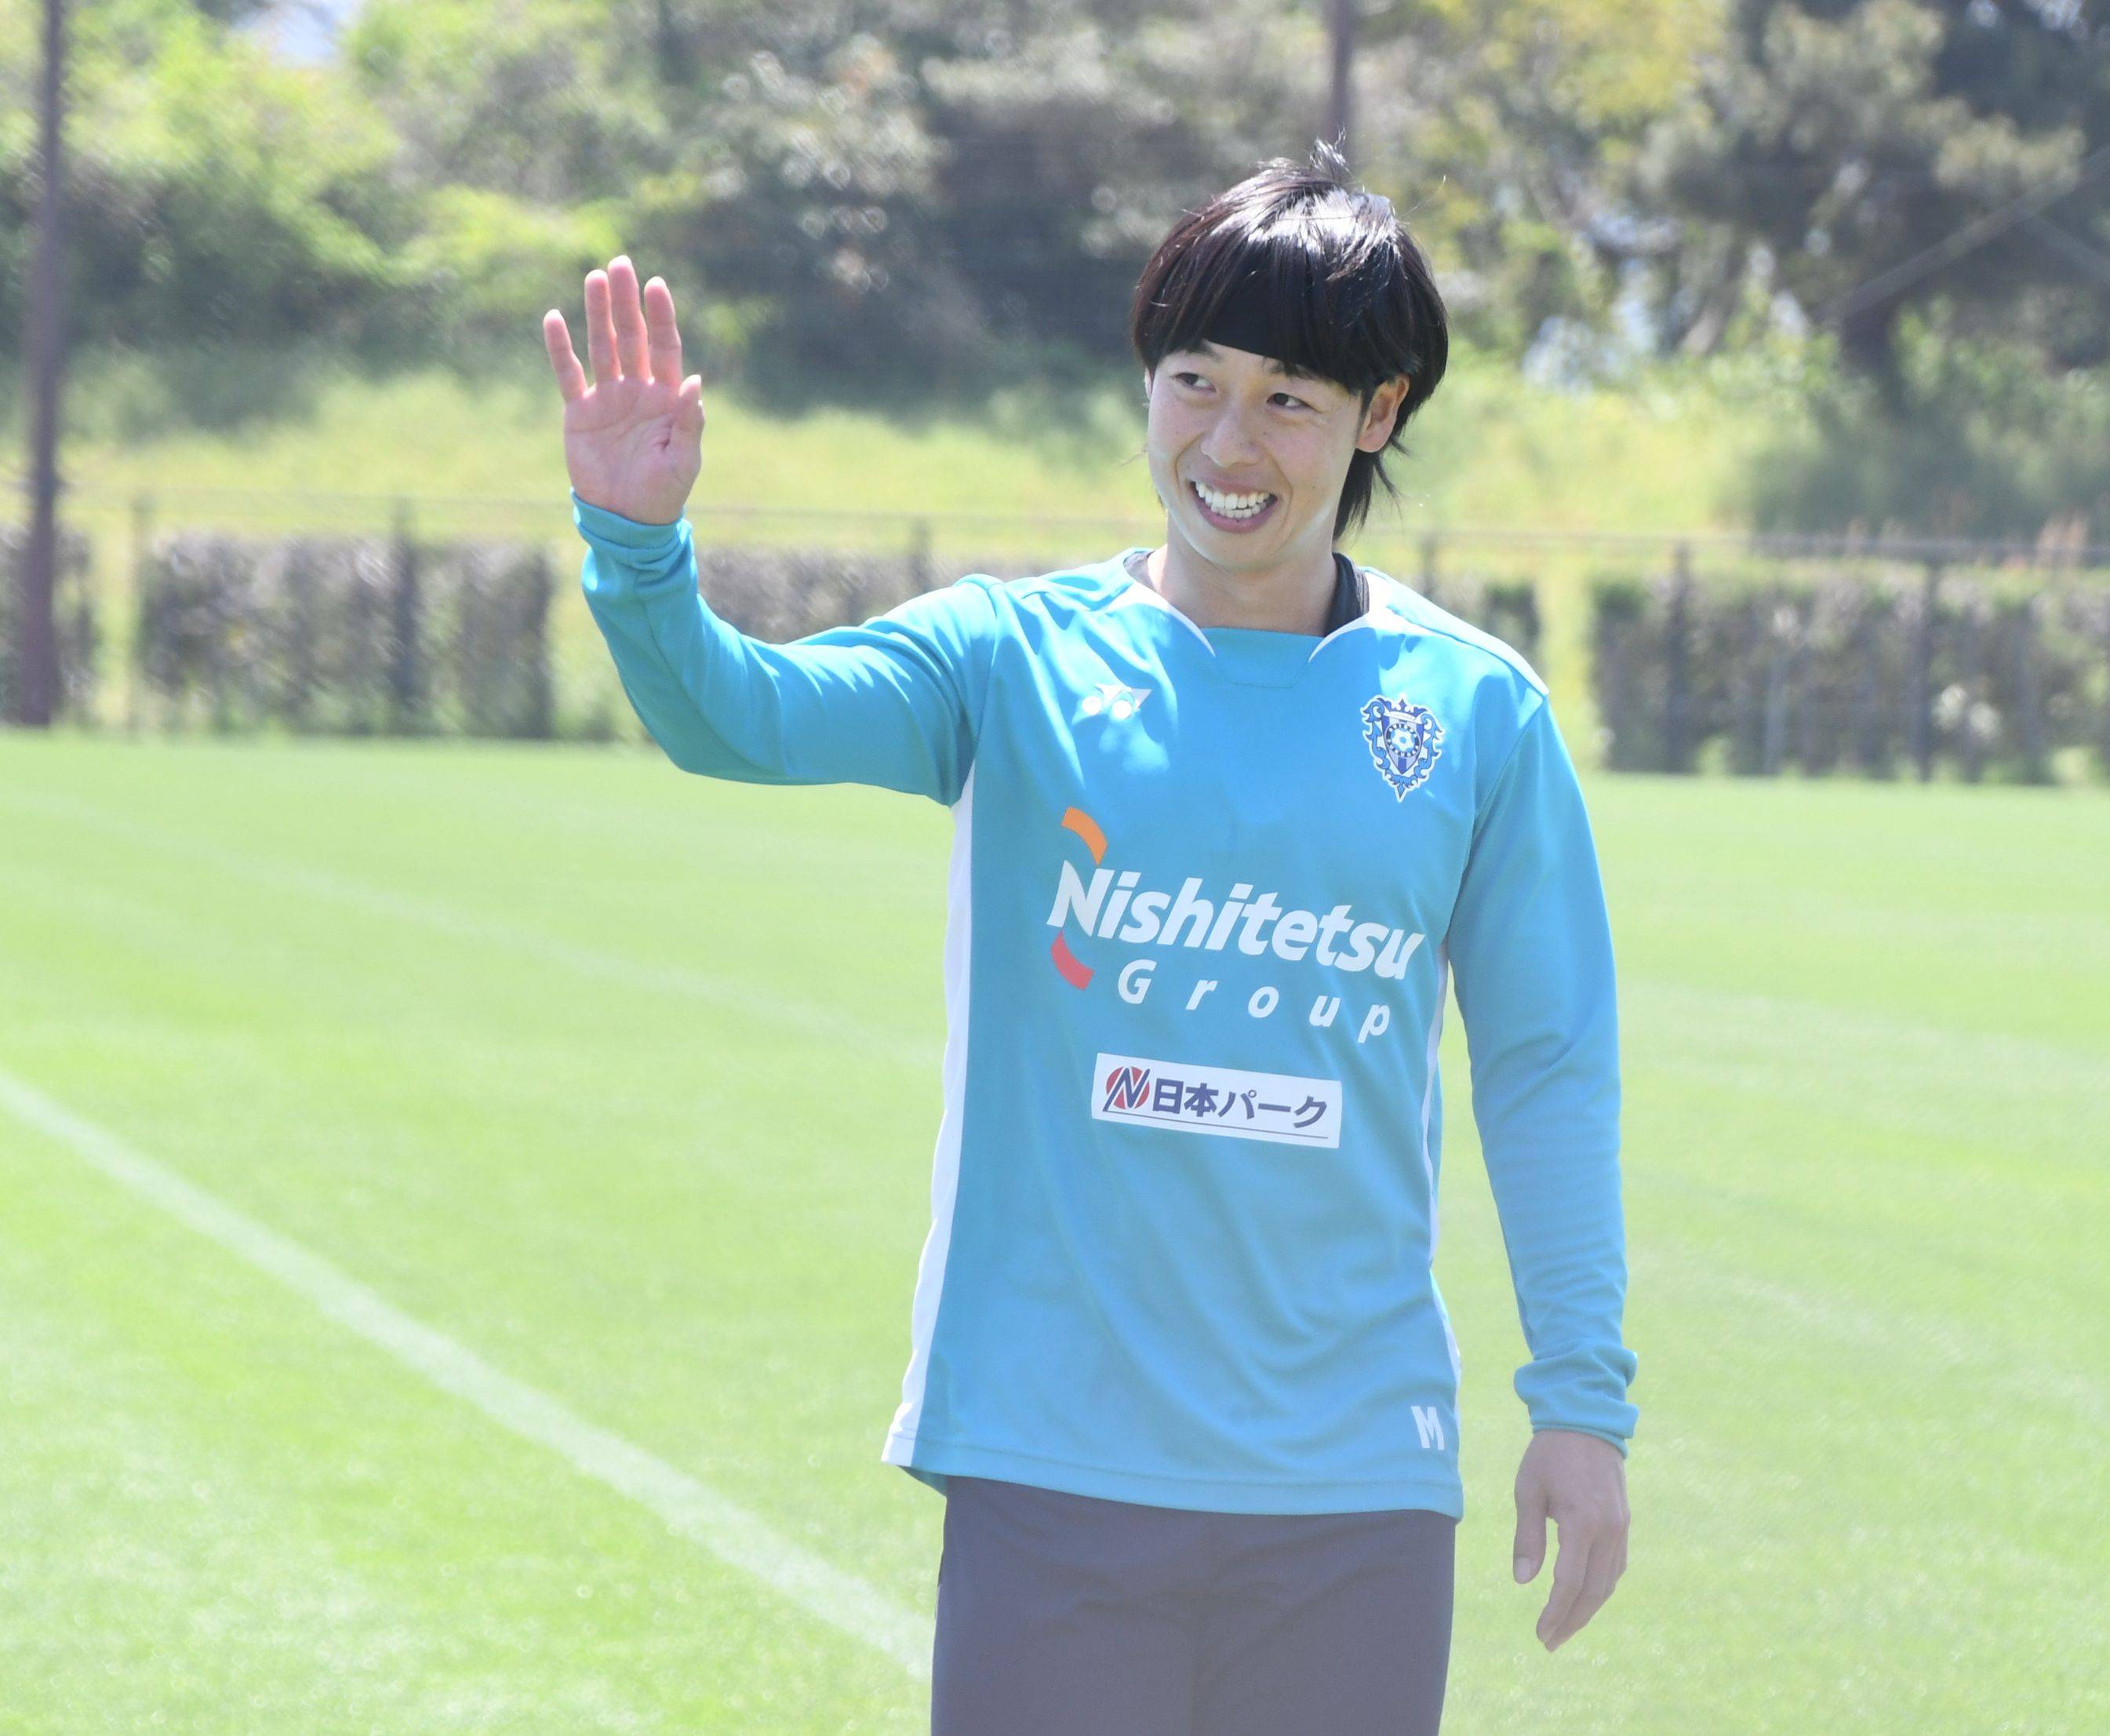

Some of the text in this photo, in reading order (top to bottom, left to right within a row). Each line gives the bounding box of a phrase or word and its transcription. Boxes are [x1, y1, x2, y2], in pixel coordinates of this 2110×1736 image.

[1046, 860, 1425, 980] Nishitetsu
[1118, 959, 1391, 1043] Group
[1152, 1078, 1327, 1129] 日本パーク
[1410, 1406, 1445, 1450] M
